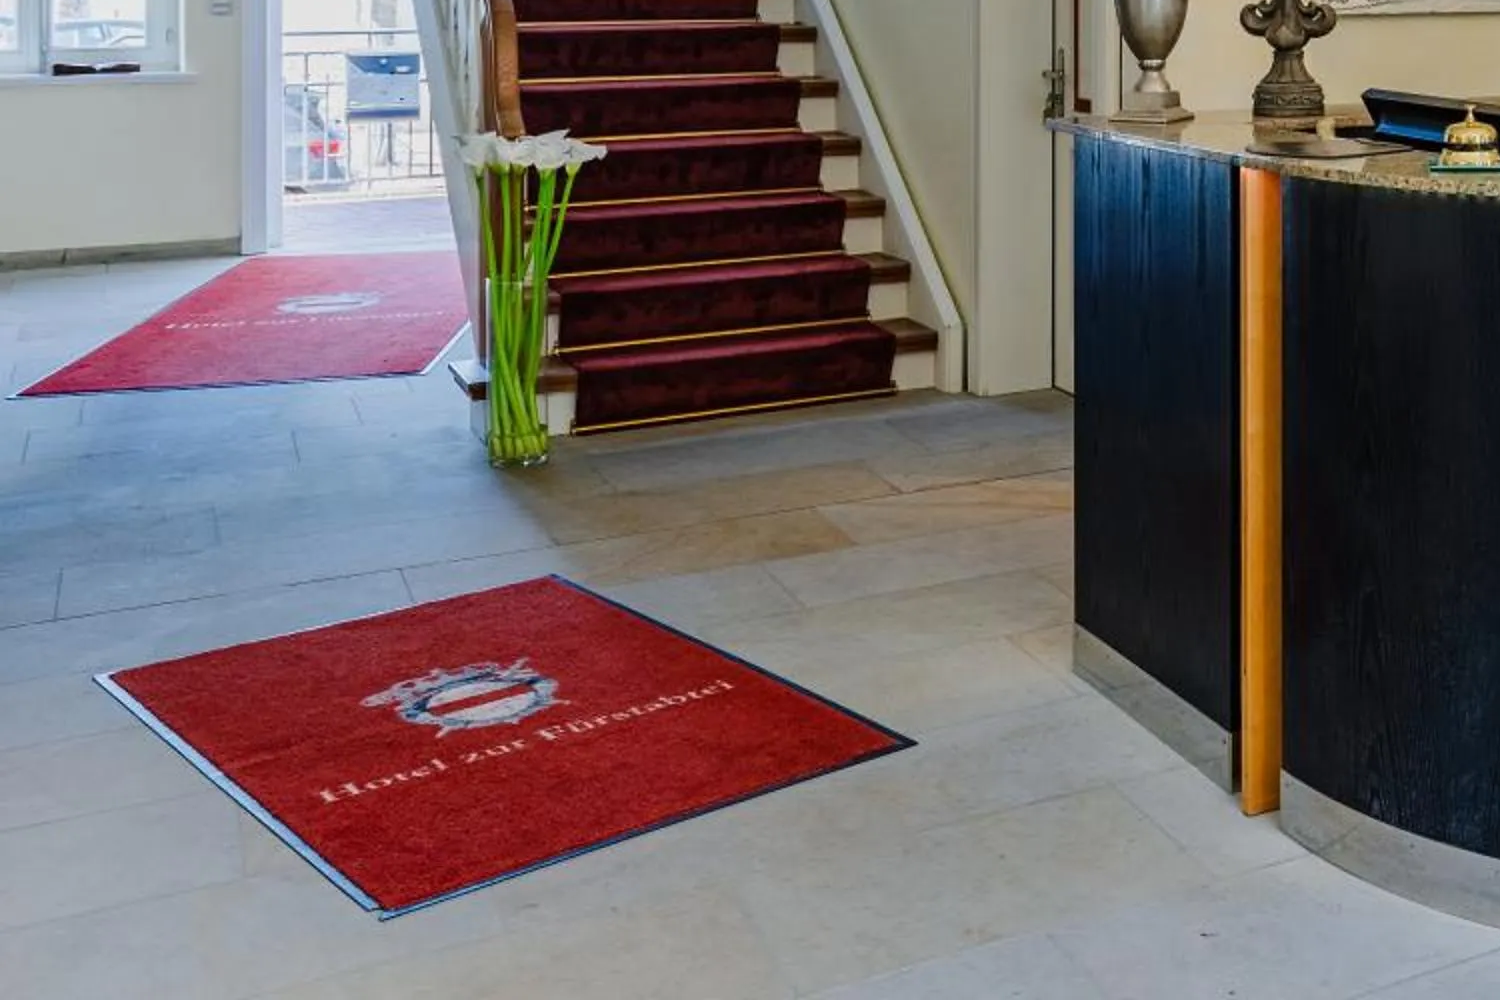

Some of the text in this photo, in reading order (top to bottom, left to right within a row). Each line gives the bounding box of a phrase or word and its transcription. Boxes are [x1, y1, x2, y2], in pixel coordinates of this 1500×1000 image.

[319, 679, 735, 804] Hotel zur Fürstabtei
